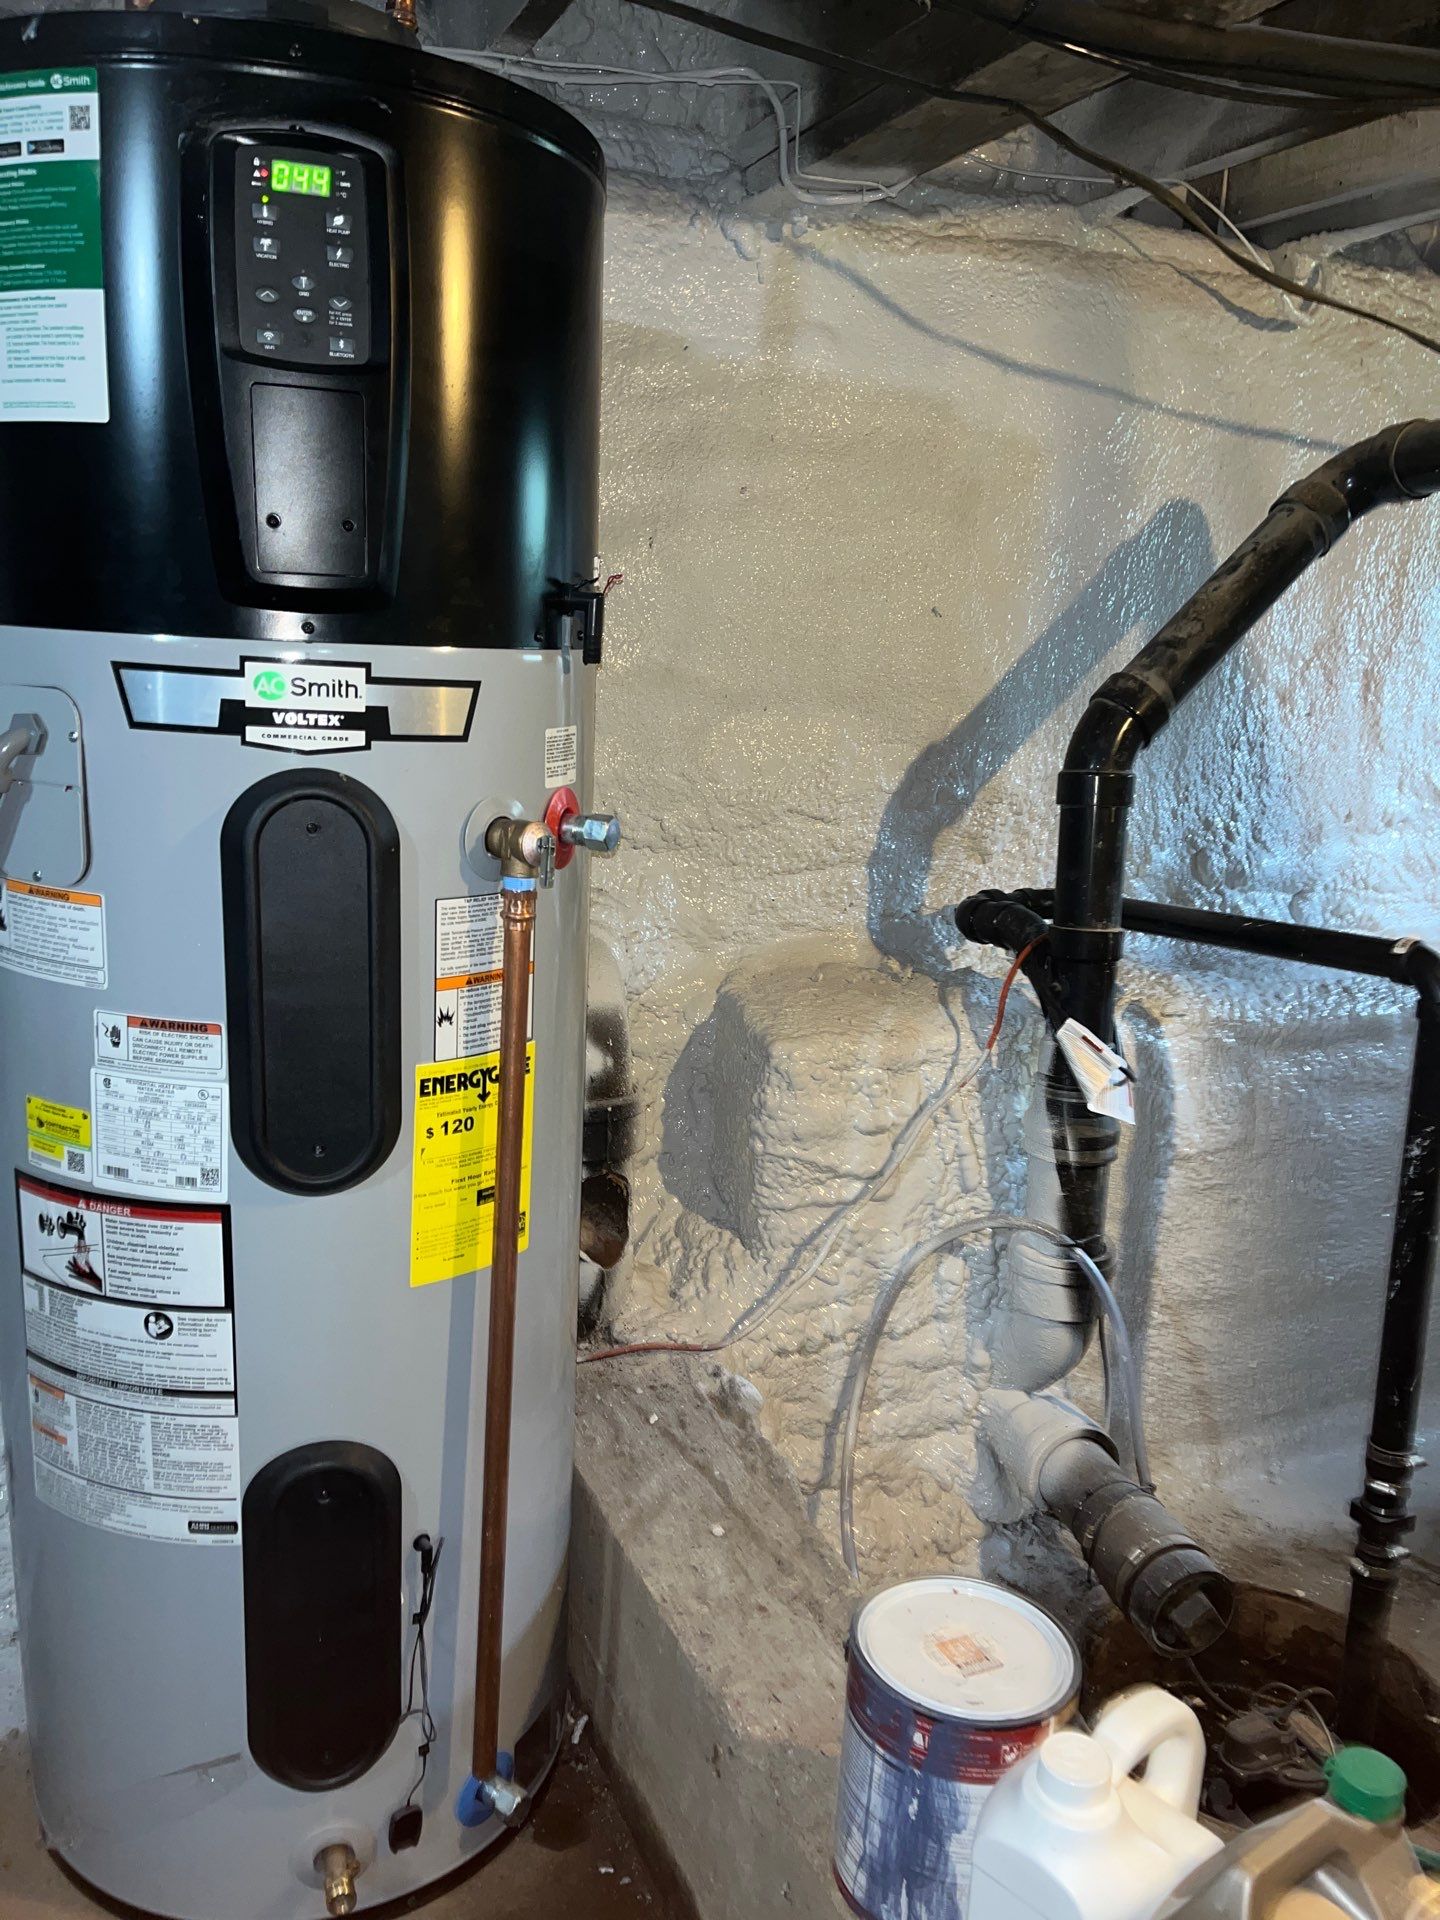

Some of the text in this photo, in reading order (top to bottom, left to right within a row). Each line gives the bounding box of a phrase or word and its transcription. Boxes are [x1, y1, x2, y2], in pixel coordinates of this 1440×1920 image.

[63, 75, 91, 86] Smith
[272, 162, 329, 196] 044
[262, 733, 318, 741] COMMERCIAL
[36, 888, 70, 901] WARNING
[473, 972, 504, 984] WARNIN
[146, 1020, 208, 1033] WARNING
[426, 1116, 474, 1139] $ 120
[90, 1202, 131, 1216] DANGER
